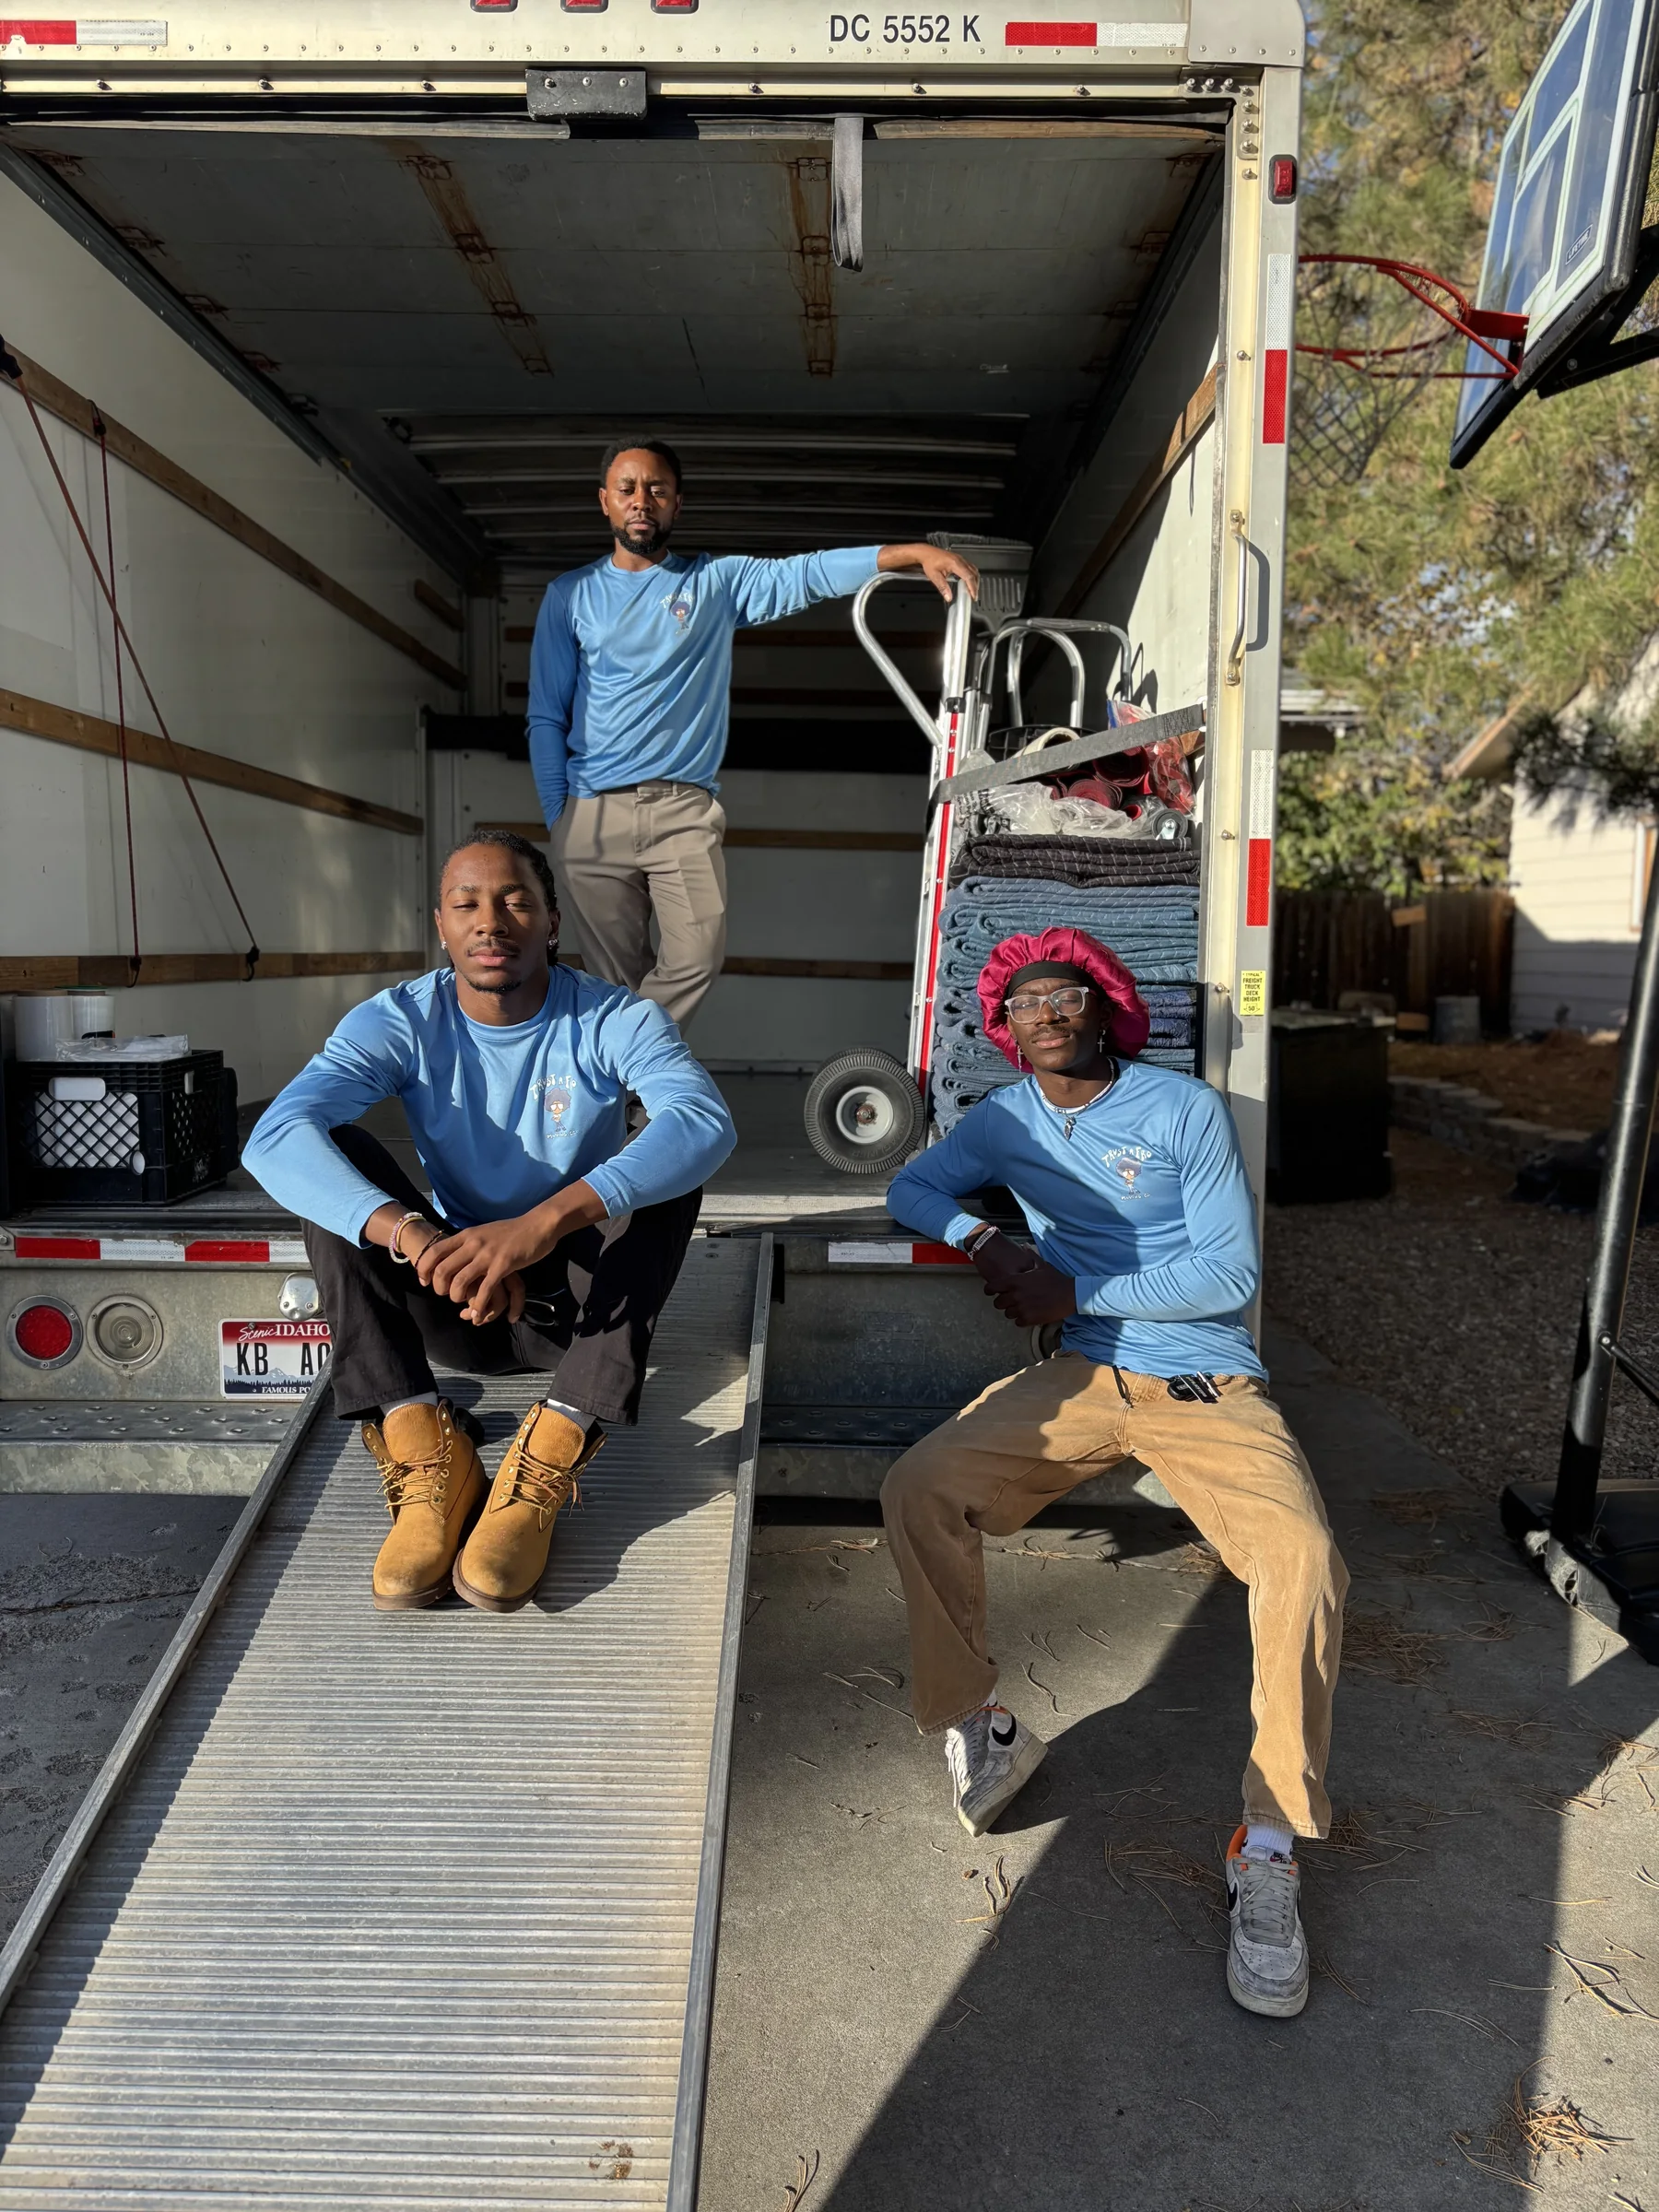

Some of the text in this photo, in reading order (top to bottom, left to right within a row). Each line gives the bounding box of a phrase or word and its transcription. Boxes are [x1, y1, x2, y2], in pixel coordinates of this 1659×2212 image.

[830, 13, 982, 44] DC 5552 K
[1100, 1146, 1127, 1169] TRUST
[1135, 1146, 1152, 1161] FRO
[238, 1324, 330, 1342] Scenic IDAHO
[236, 1342, 269, 1376] KB
